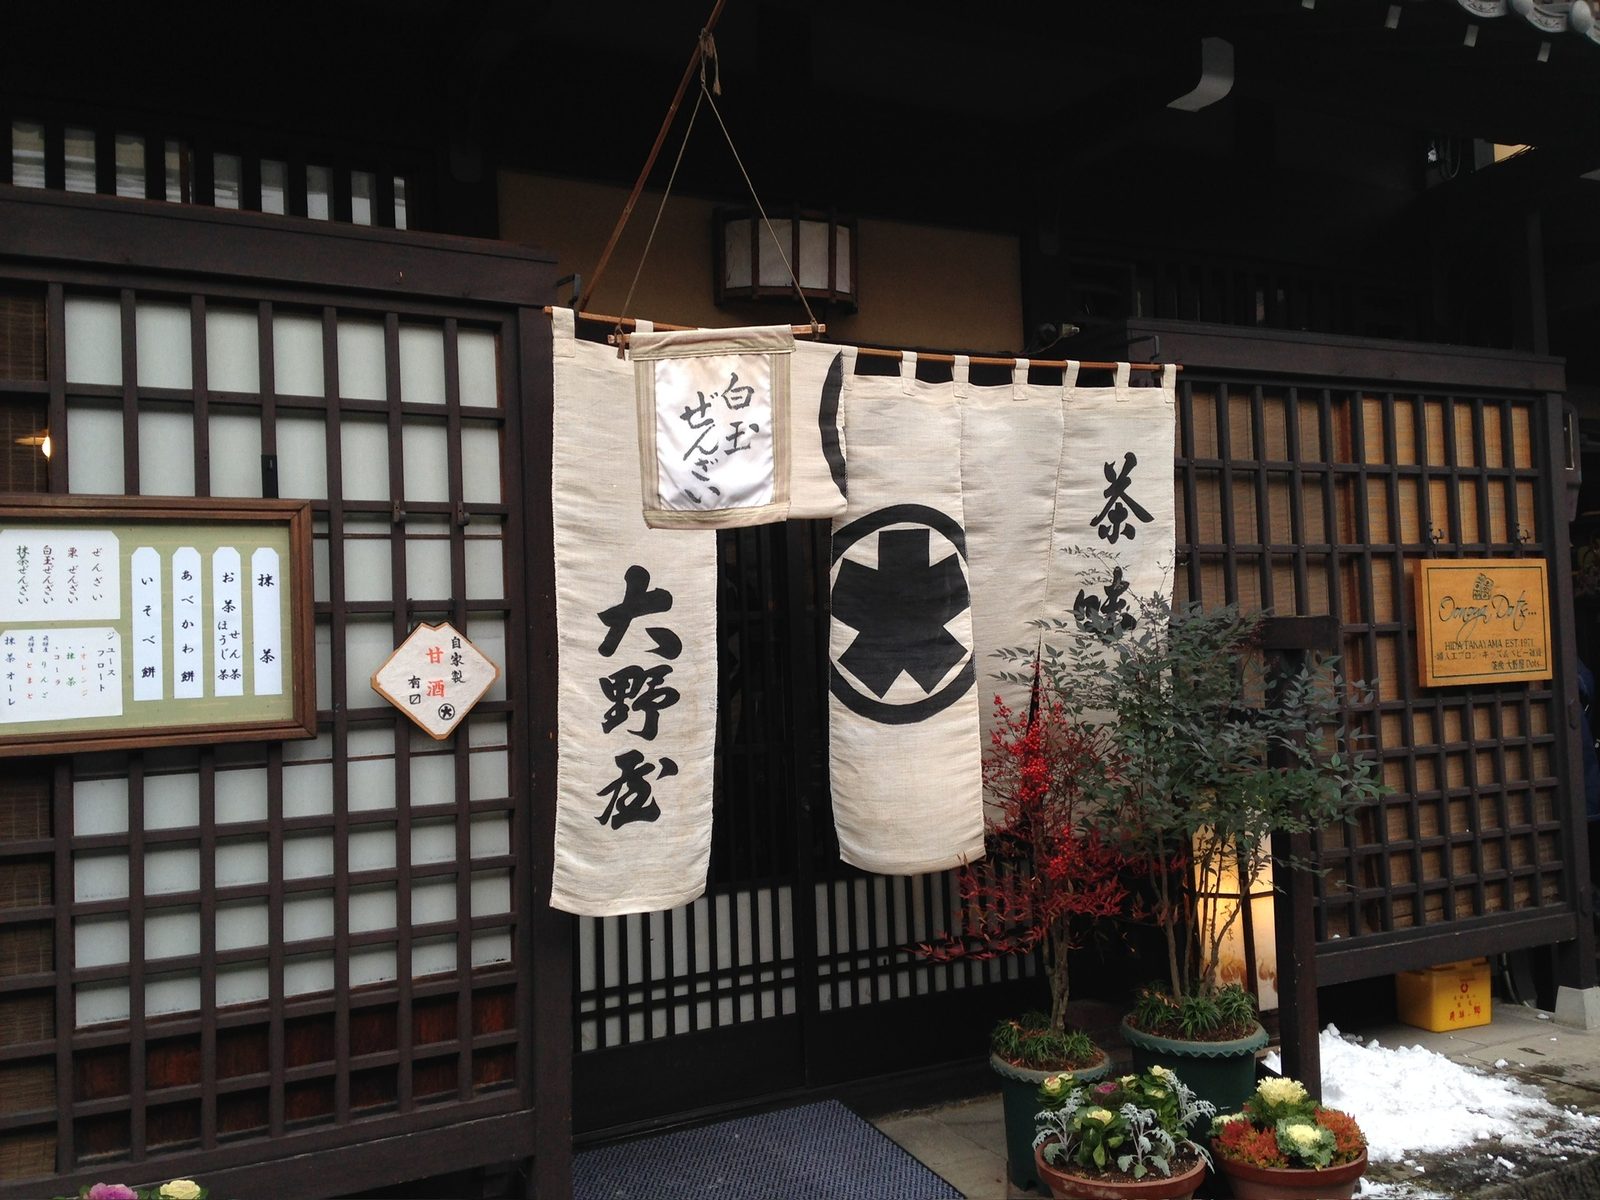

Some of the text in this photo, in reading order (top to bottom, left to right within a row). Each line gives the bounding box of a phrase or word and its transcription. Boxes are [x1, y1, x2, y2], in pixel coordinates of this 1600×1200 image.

[680, 391, 720, 504] ぜんざい
[721, 372, 760, 455] 白玉
[43, 545, 55, 604] 白玉ぜんざい
[91, 547, 103, 601] ぜんざい
[141, 577, 156, 679] いそべ餅
[181, 570, 195, 683] あべかわ餅
[257, 573, 275, 664] 抹茶
[450, 636, 466, 684] 自家製
[97, 650, 105, 692] フロート
[425, 646, 445, 698] 甘酒
[595, 565, 682, 830] 大野屋
